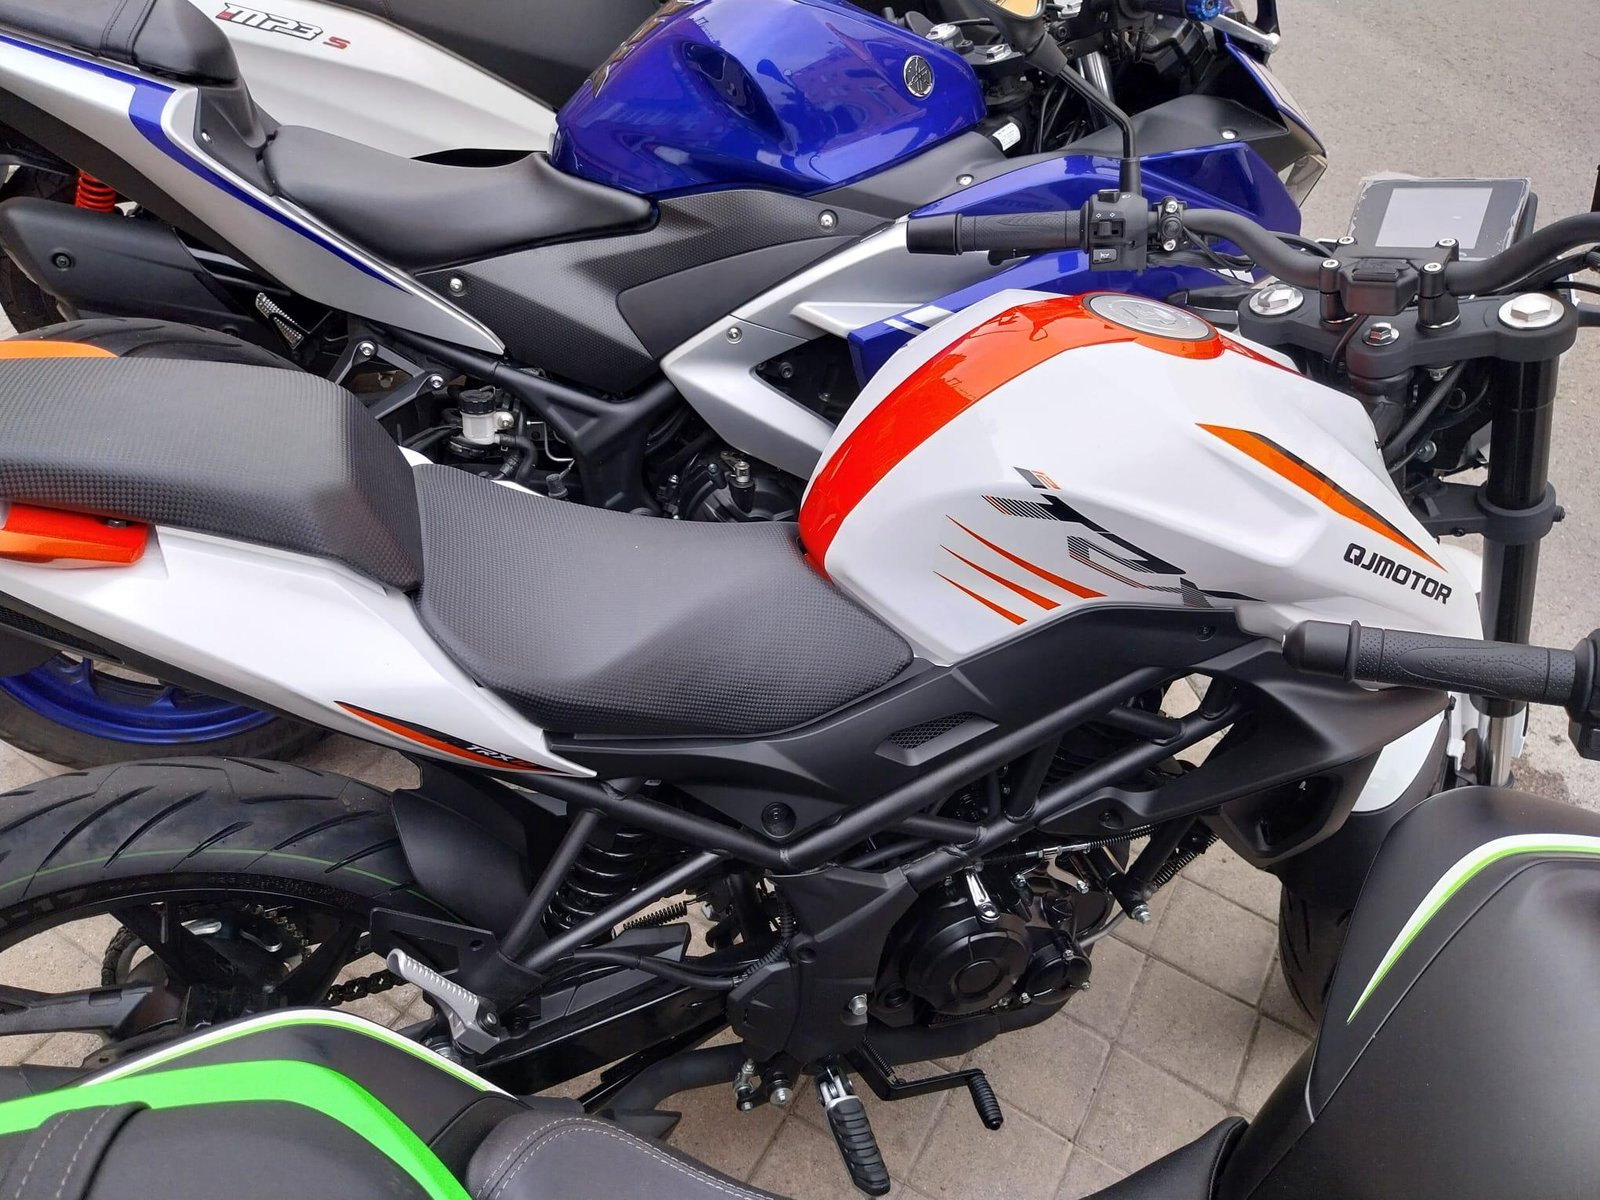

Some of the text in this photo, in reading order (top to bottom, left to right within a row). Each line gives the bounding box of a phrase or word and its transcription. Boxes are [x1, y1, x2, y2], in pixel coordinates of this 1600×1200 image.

[216, 2, 351, 50] MP3 S
[1343, 542, 1452, 605] QJMOTOR
